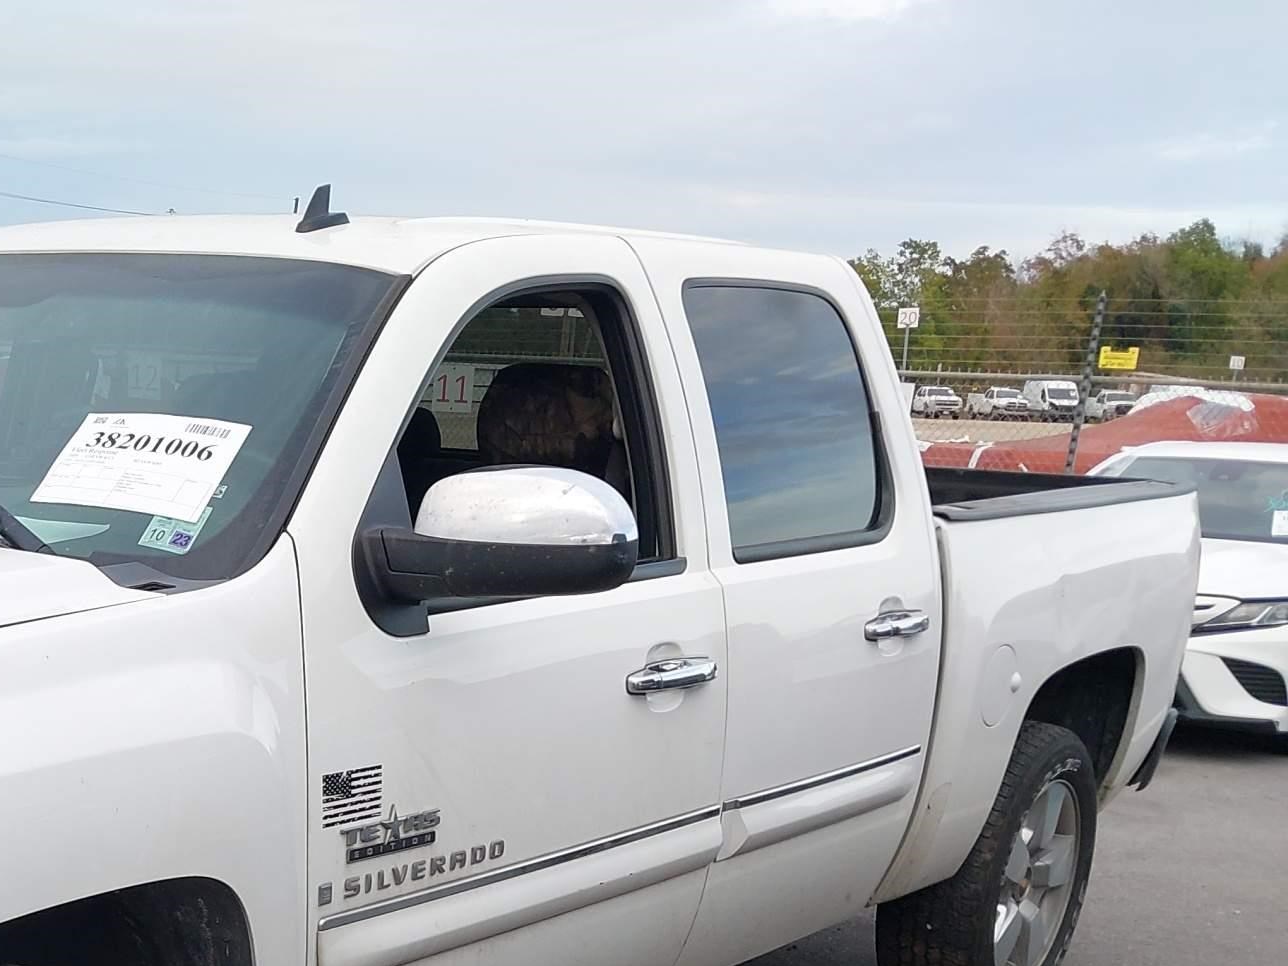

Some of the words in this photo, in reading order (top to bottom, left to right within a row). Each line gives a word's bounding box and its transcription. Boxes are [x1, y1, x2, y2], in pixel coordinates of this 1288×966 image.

[900, 311, 918, 325] 20
[131, 364, 158, 391] 12
[437, 374, 469, 404] 11
[86, 431, 219, 462] 38201006
[150, 528, 167, 542] 10
[171, 532, 192, 547] 23
[352, 832, 434, 859] EDITION
[343, 839, 505, 899] SILVERADO
